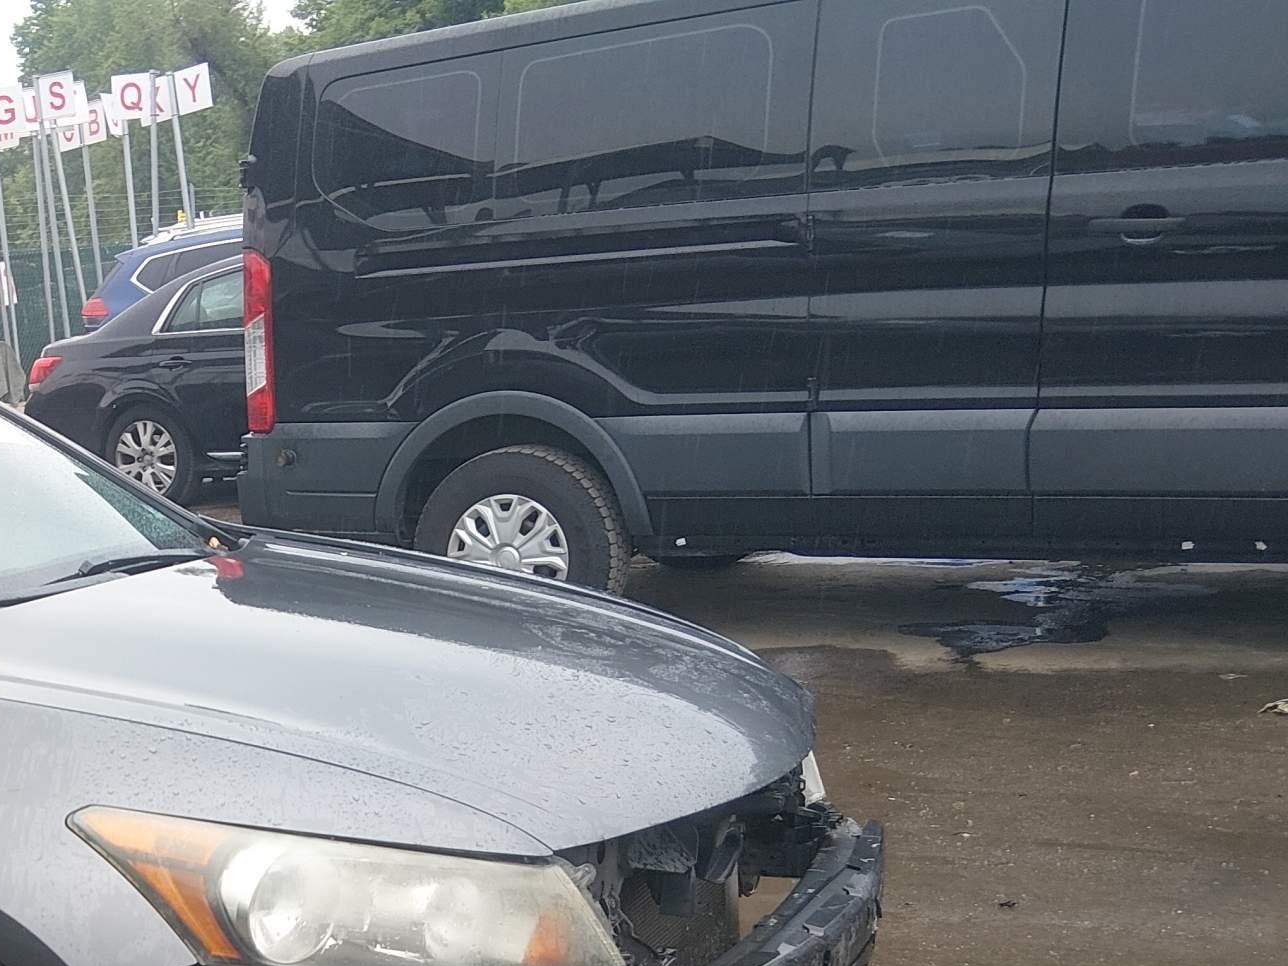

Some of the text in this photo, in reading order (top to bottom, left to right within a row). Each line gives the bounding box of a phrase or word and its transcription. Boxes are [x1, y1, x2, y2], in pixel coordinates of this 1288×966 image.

[49, 80, 66, 110] S
[120, 82, 143, 111] Q
[183, 74, 200, 102] Y
